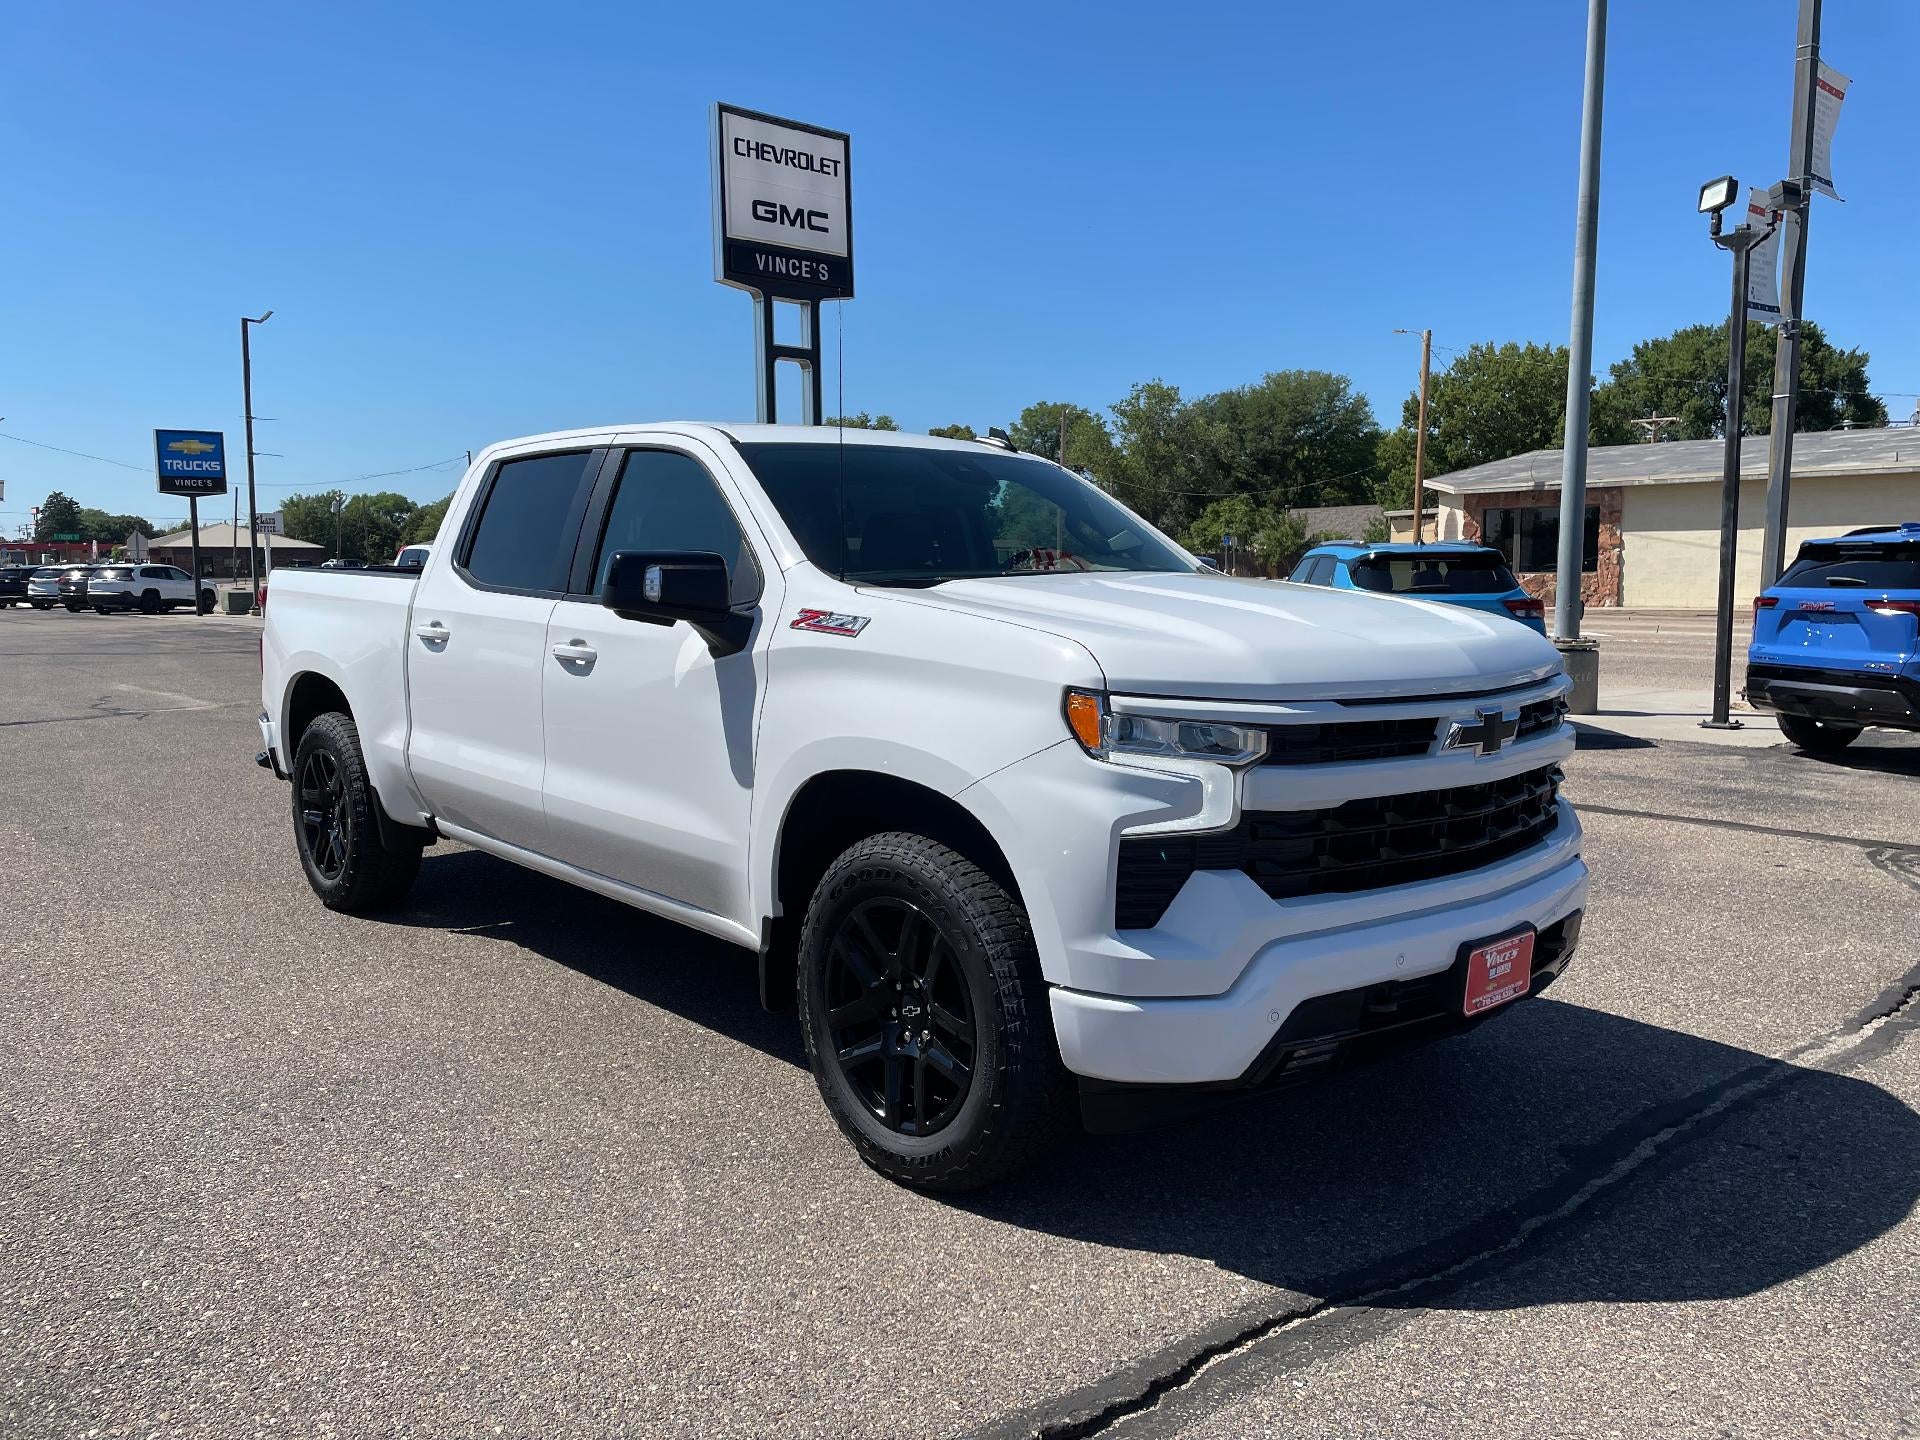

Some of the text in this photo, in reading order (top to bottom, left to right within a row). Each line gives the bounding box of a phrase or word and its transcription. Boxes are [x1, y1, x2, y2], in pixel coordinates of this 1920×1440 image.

[734, 137, 840, 177] CHEVROLET
[752, 200, 829, 233] GMC
[756, 253, 829, 280] VINCE'S
[164, 460, 220, 471] TRUCKS
[1799, 601, 1835, 611] GMC
[789, 608, 871, 638] Z71
